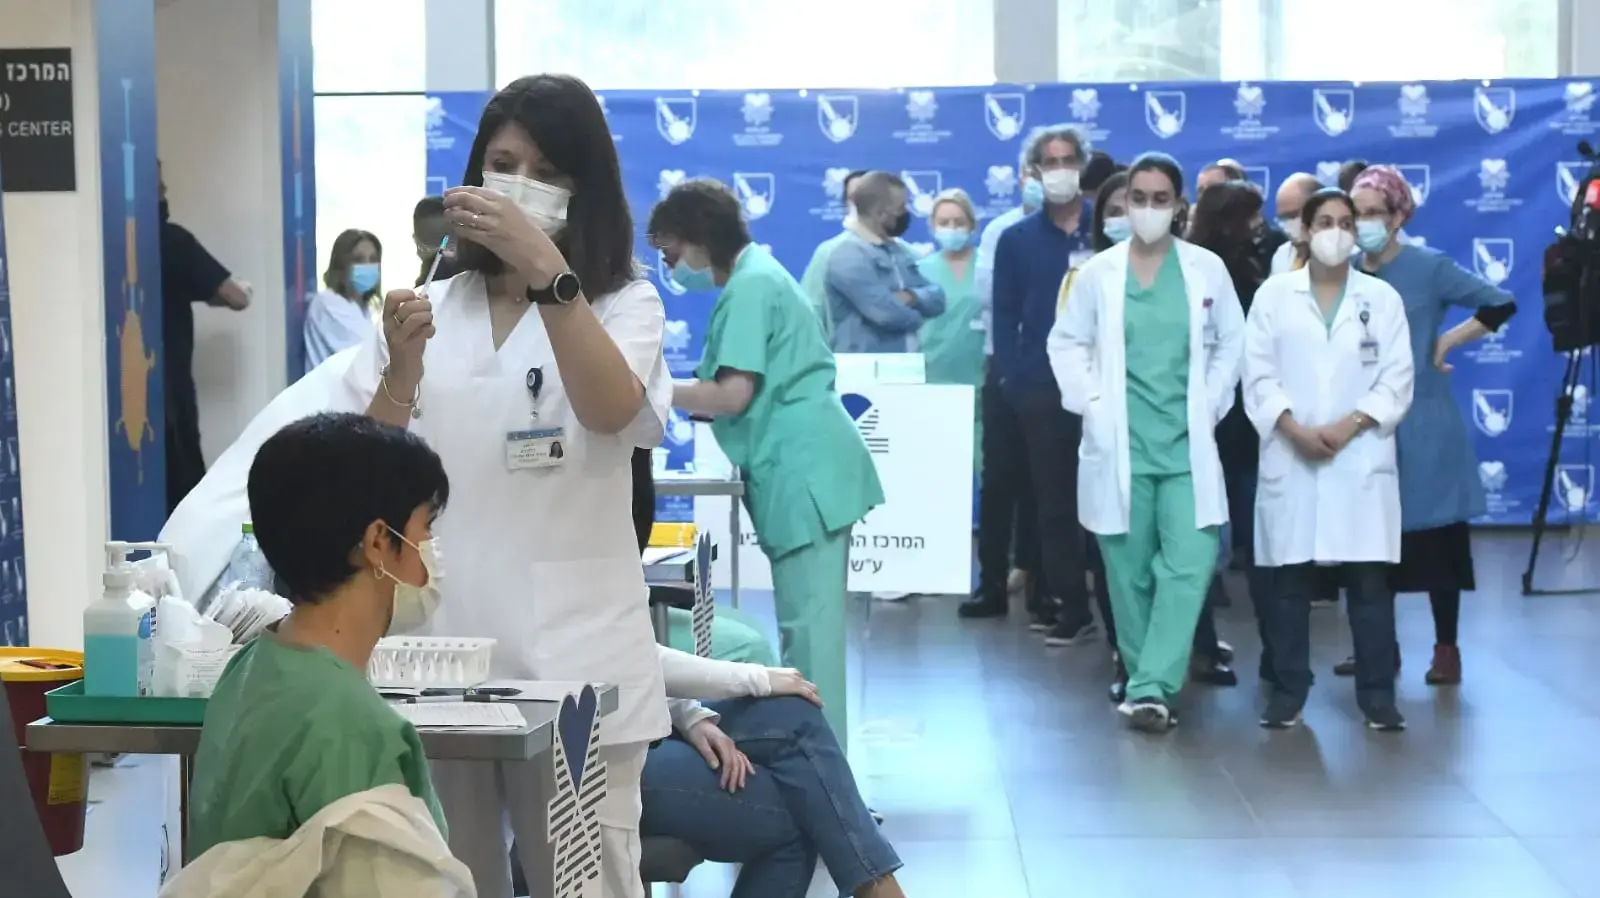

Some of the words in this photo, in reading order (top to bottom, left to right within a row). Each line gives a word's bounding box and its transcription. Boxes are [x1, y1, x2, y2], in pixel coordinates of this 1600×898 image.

[5, 62, 70, 82] המרכז
[8, 120, 73, 137] CENTER
[873, 535, 926, 550] המרכז
